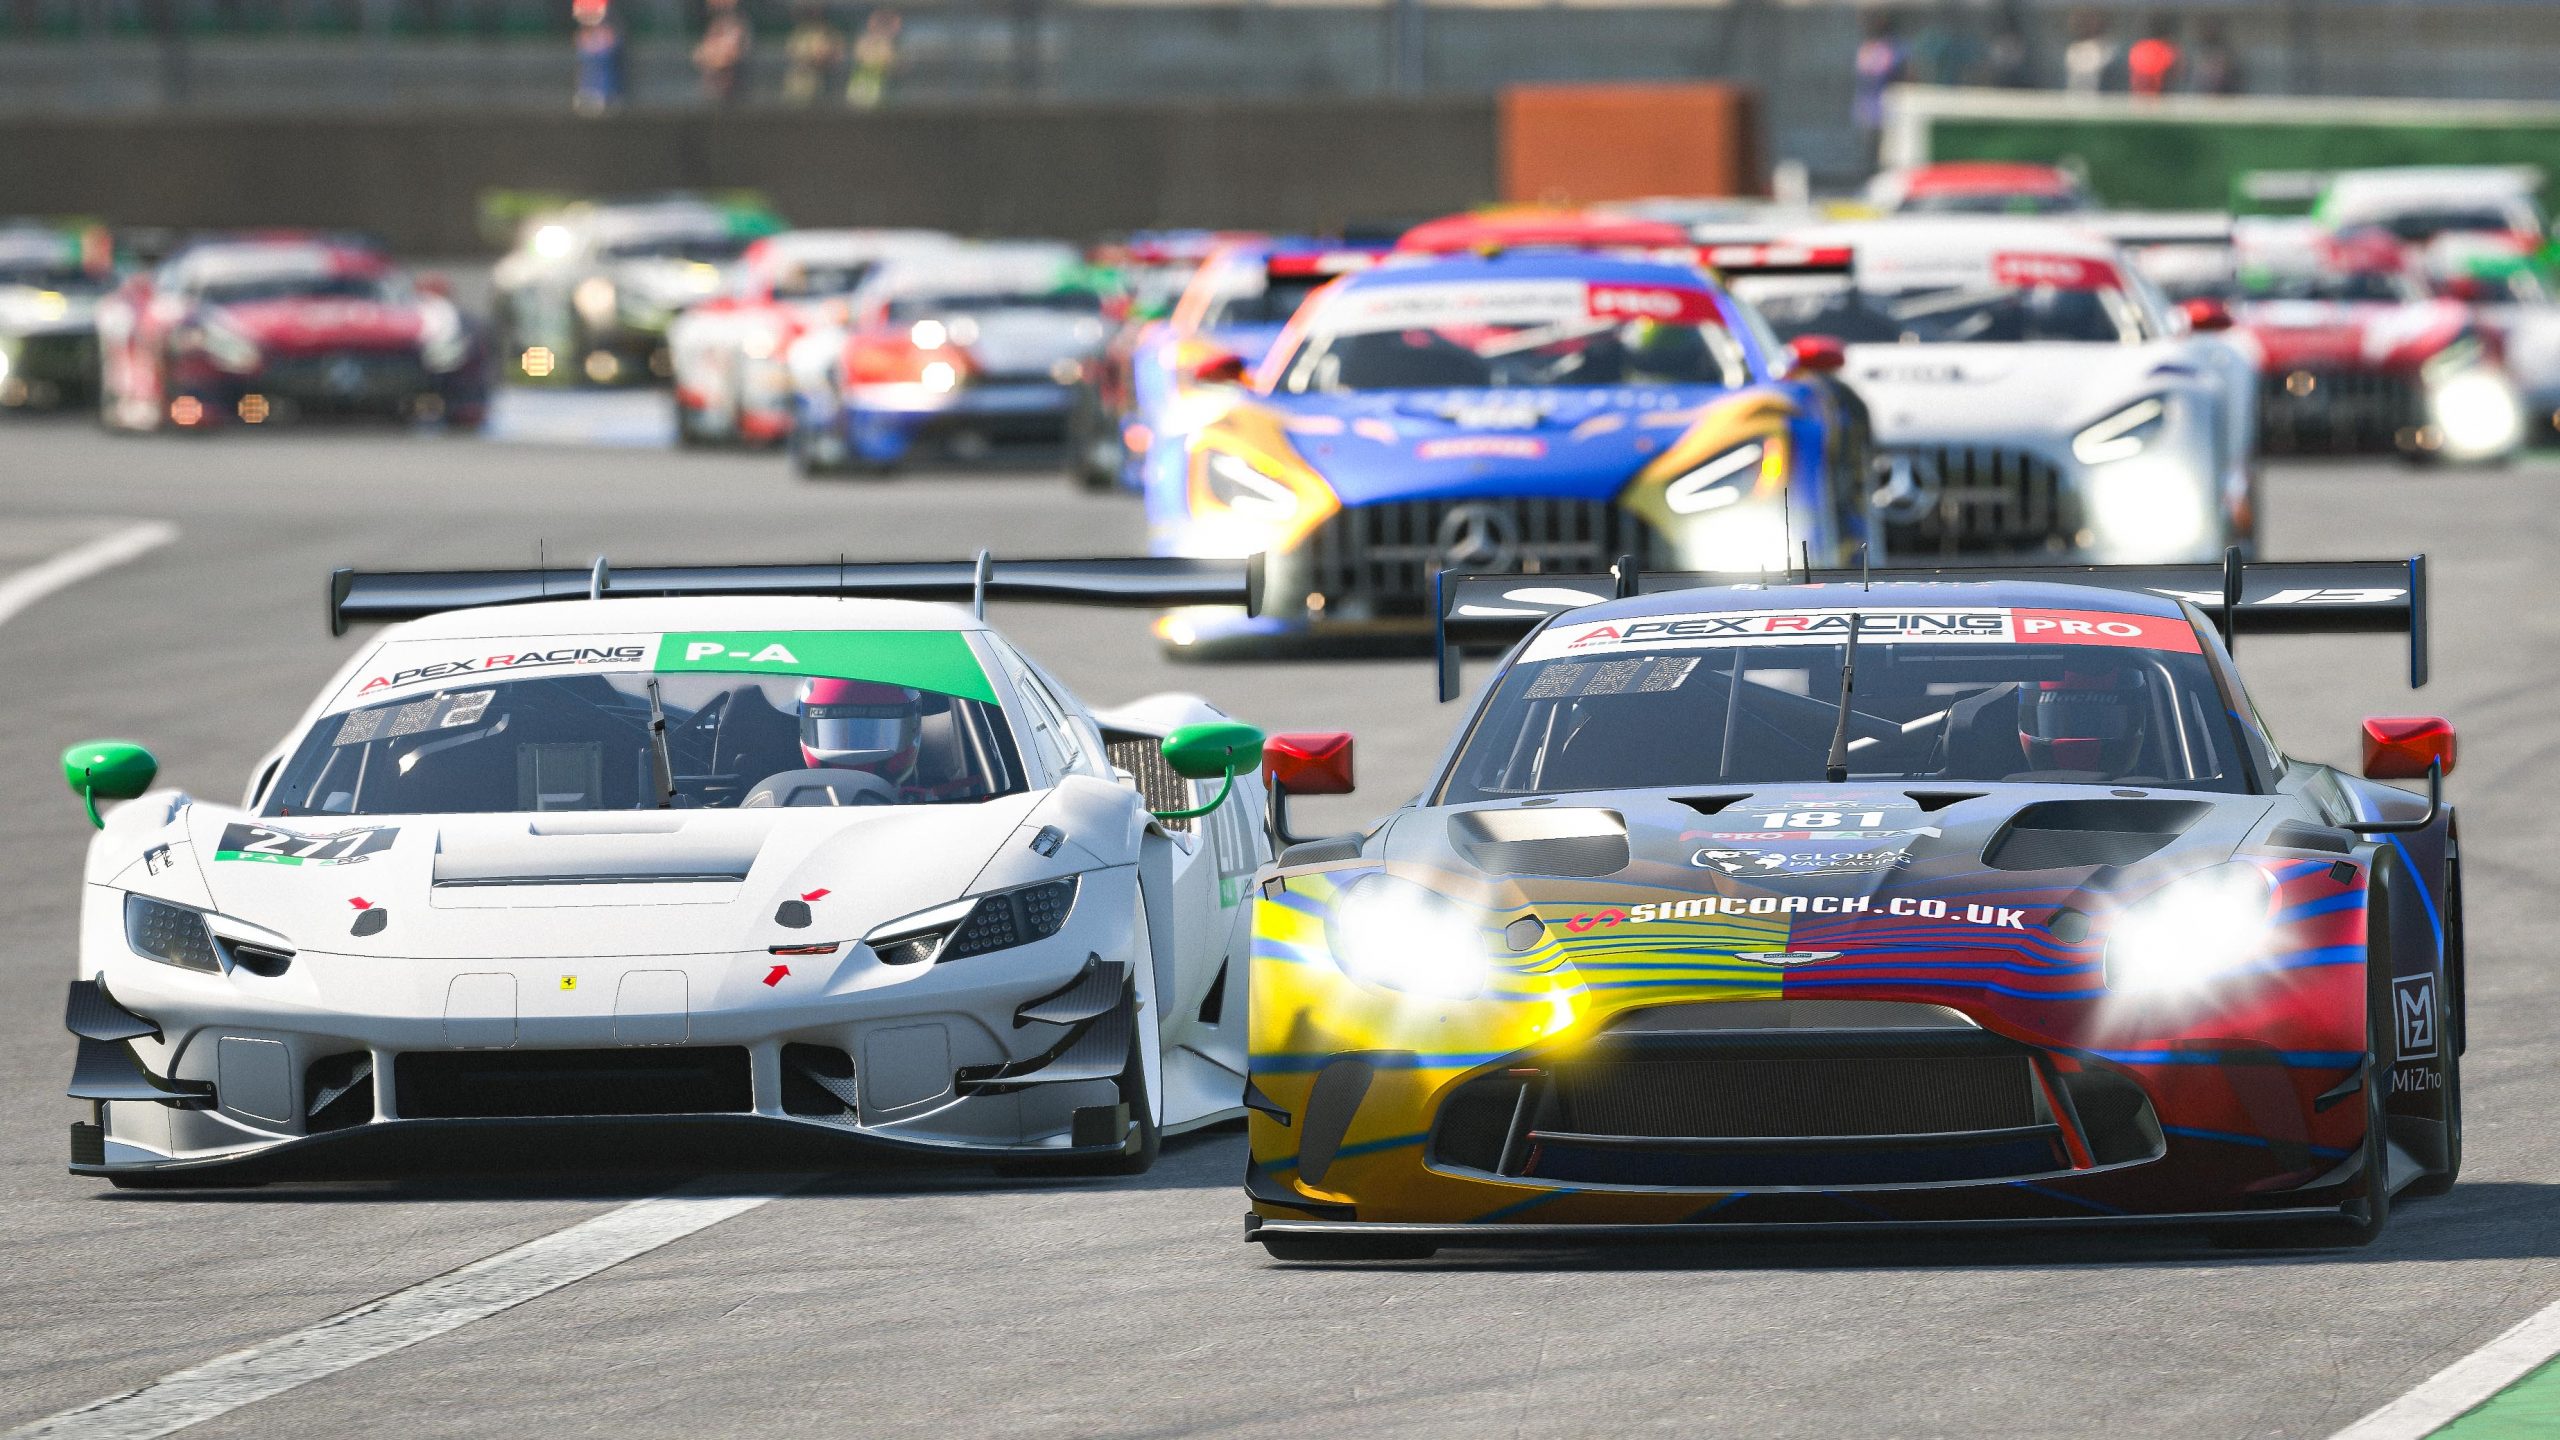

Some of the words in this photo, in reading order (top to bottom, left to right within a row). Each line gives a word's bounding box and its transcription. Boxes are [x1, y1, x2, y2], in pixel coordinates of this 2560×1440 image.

[1573, 617, 1753, 643] APEX
[1764, 614, 2003, 632] RACING
[2023, 619, 2142, 637] PRO
[575, 657, 641, 665] LEAGUE
[685, 642, 799, 664] P-A
[360, 658, 477, 691] APEX
[485, 646, 645, 668] RACING
[1752, 811, 1884, 829] 181
[244, 829, 374, 858] 271
[1711, 832, 1784, 840] PRO
[239, 852, 280, 863] P-A
[1789, 856, 1911, 867] PACKAGING
[1790, 848, 1914, 861] GLOBAL
[1630, 895, 2026, 931] SIMCOACH.CO.UK
[2391, 1066, 2442, 1093] MiZho
